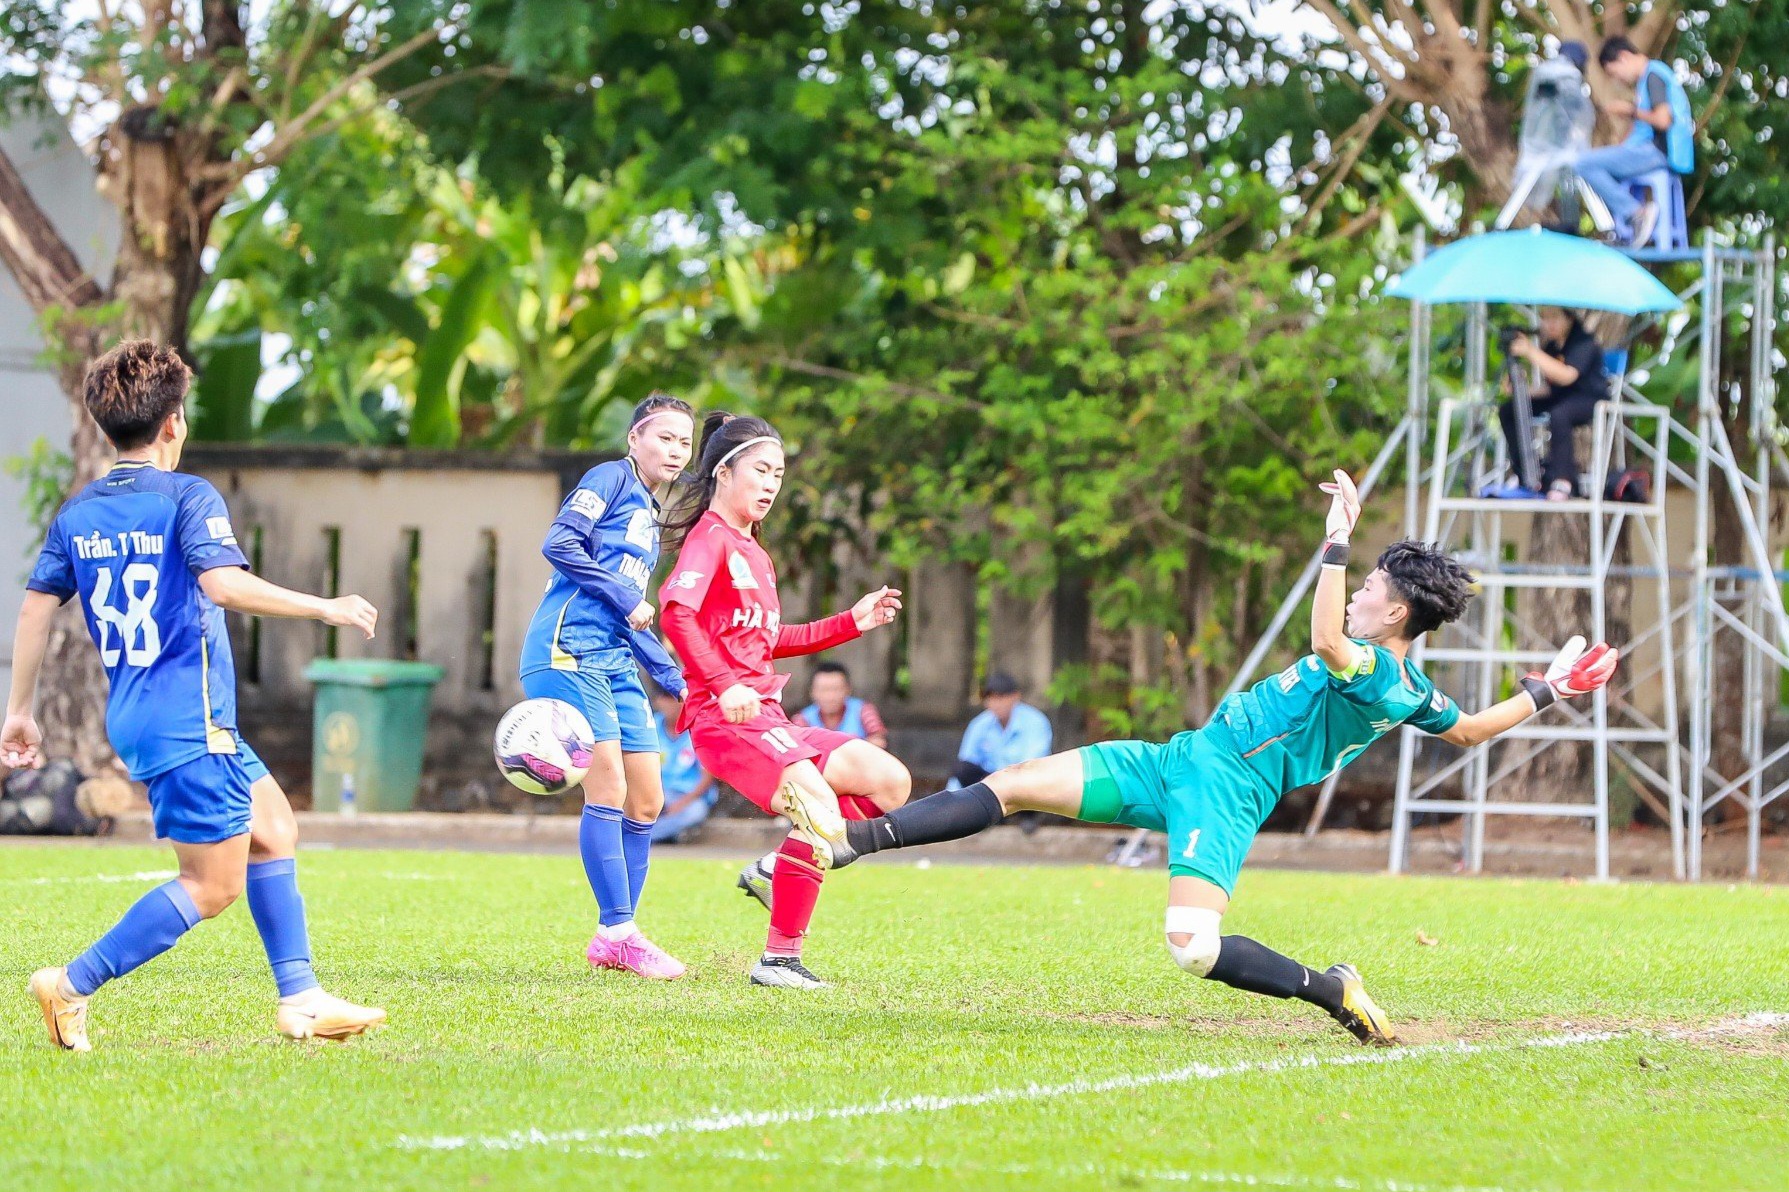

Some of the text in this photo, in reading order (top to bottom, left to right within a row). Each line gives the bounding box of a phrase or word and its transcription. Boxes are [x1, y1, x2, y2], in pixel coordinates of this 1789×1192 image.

[130, 530, 163, 555] Thu
[90, 563, 162, 667] 68
[732, 601, 763, 629] HÀ
[1182, 828, 1201, 858] 1
